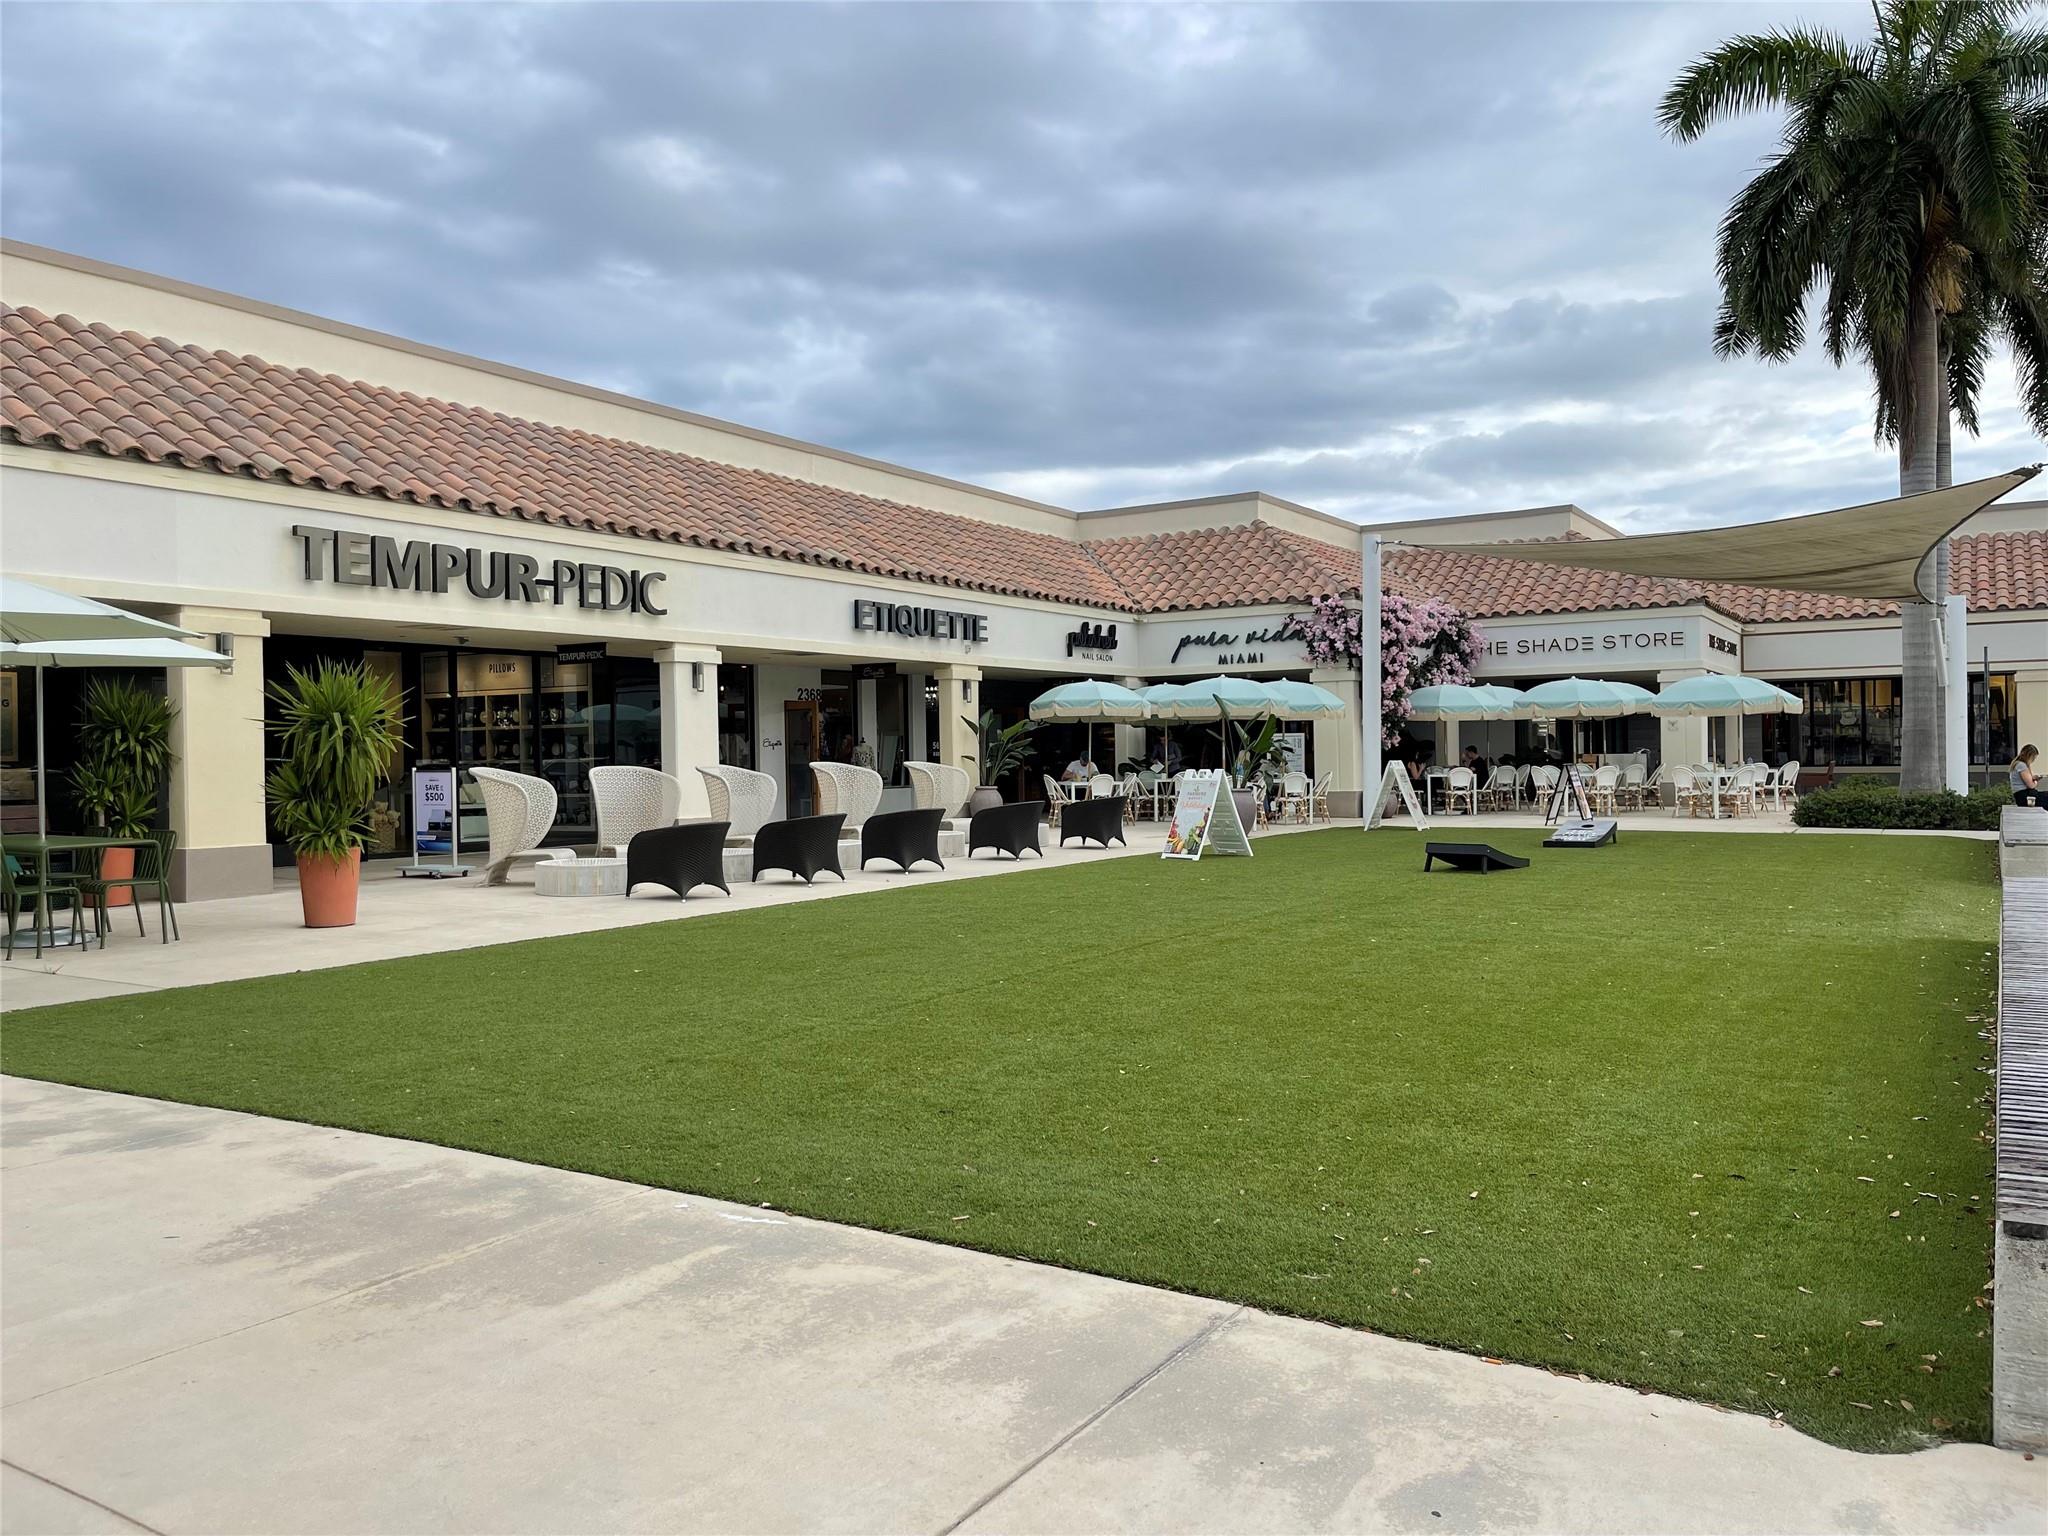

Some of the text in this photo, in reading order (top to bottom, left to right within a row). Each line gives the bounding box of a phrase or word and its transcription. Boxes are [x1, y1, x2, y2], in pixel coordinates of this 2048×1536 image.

[292, 524, 668, 616] TEMPUR-PEDIC
[854, 599, 988, 642] ETIQUETTE
[1171, 631, 1239, 663] pura
[1480, 631, 1684, 656] HE SHADE STORE
[1082, 652, 1113, 662] NAIL SALON
[1218, 652, 1264, 665] MIAMI
[488, 662, 516, 674] PILLOWS
[797, 688, 822, 701] 2368
[425, 784, 440, 792] SAVE
[425, 792, 445, 802] $500
